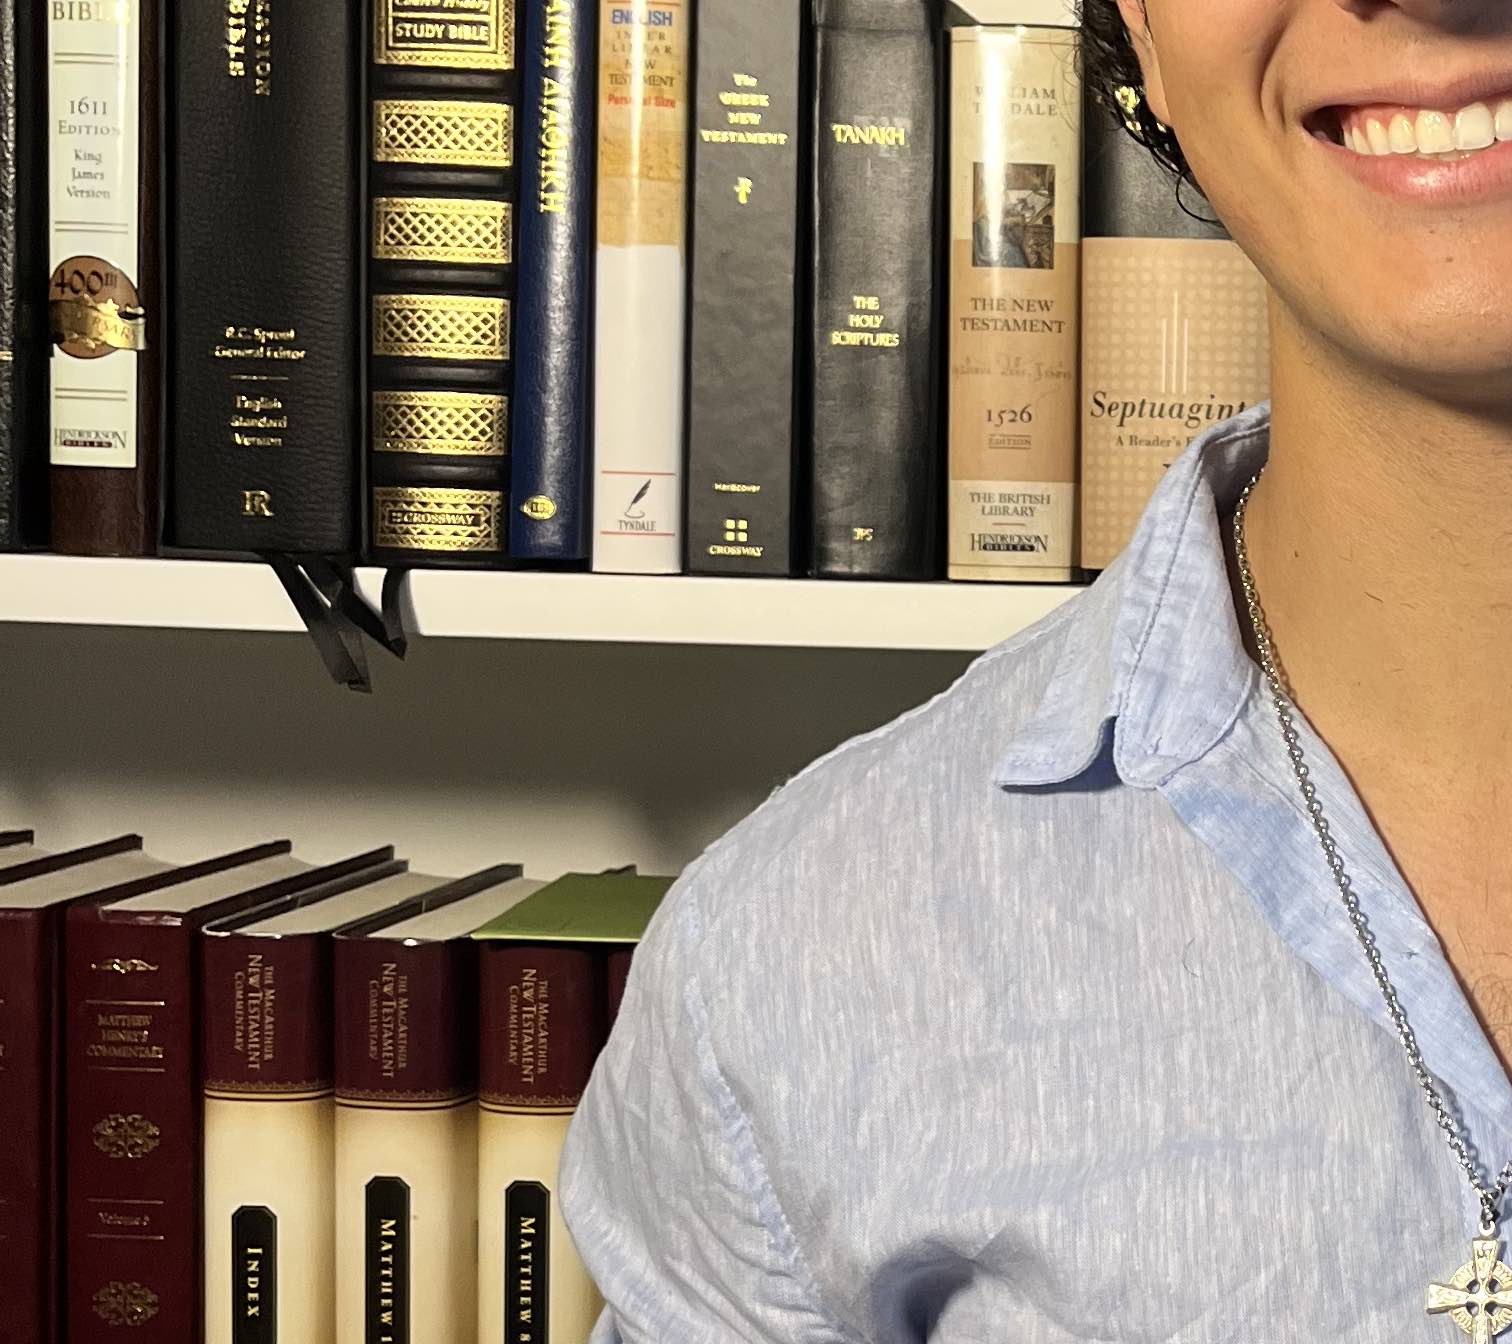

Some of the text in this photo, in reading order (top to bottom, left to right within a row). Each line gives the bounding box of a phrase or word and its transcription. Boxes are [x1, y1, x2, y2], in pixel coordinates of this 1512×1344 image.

[70, 99, 107, 115] 1611
[833, 123, 905, 146] TANAKH
[74, 149, 102, 164] King
[854, 296, 879, 310] THE
[970, 297, 1054, 313] THE NEW
[850, 315, 883, 329] HOLY
[960, 318, 1065, 333] TESTAMENT
[832, 332, 899, 348] SCRIPTURES
[986, 406, 1032, 425] 1526
[969, 492, 1051, 506] THE BRITISH
[981, 504, 1036, 516] LIBRARY
[380, 1218, 396, 1326] MATTHEW
[520, 1217, 535, 1325] MATTHEW
[246, 1248, 261, 1316] INDEX
